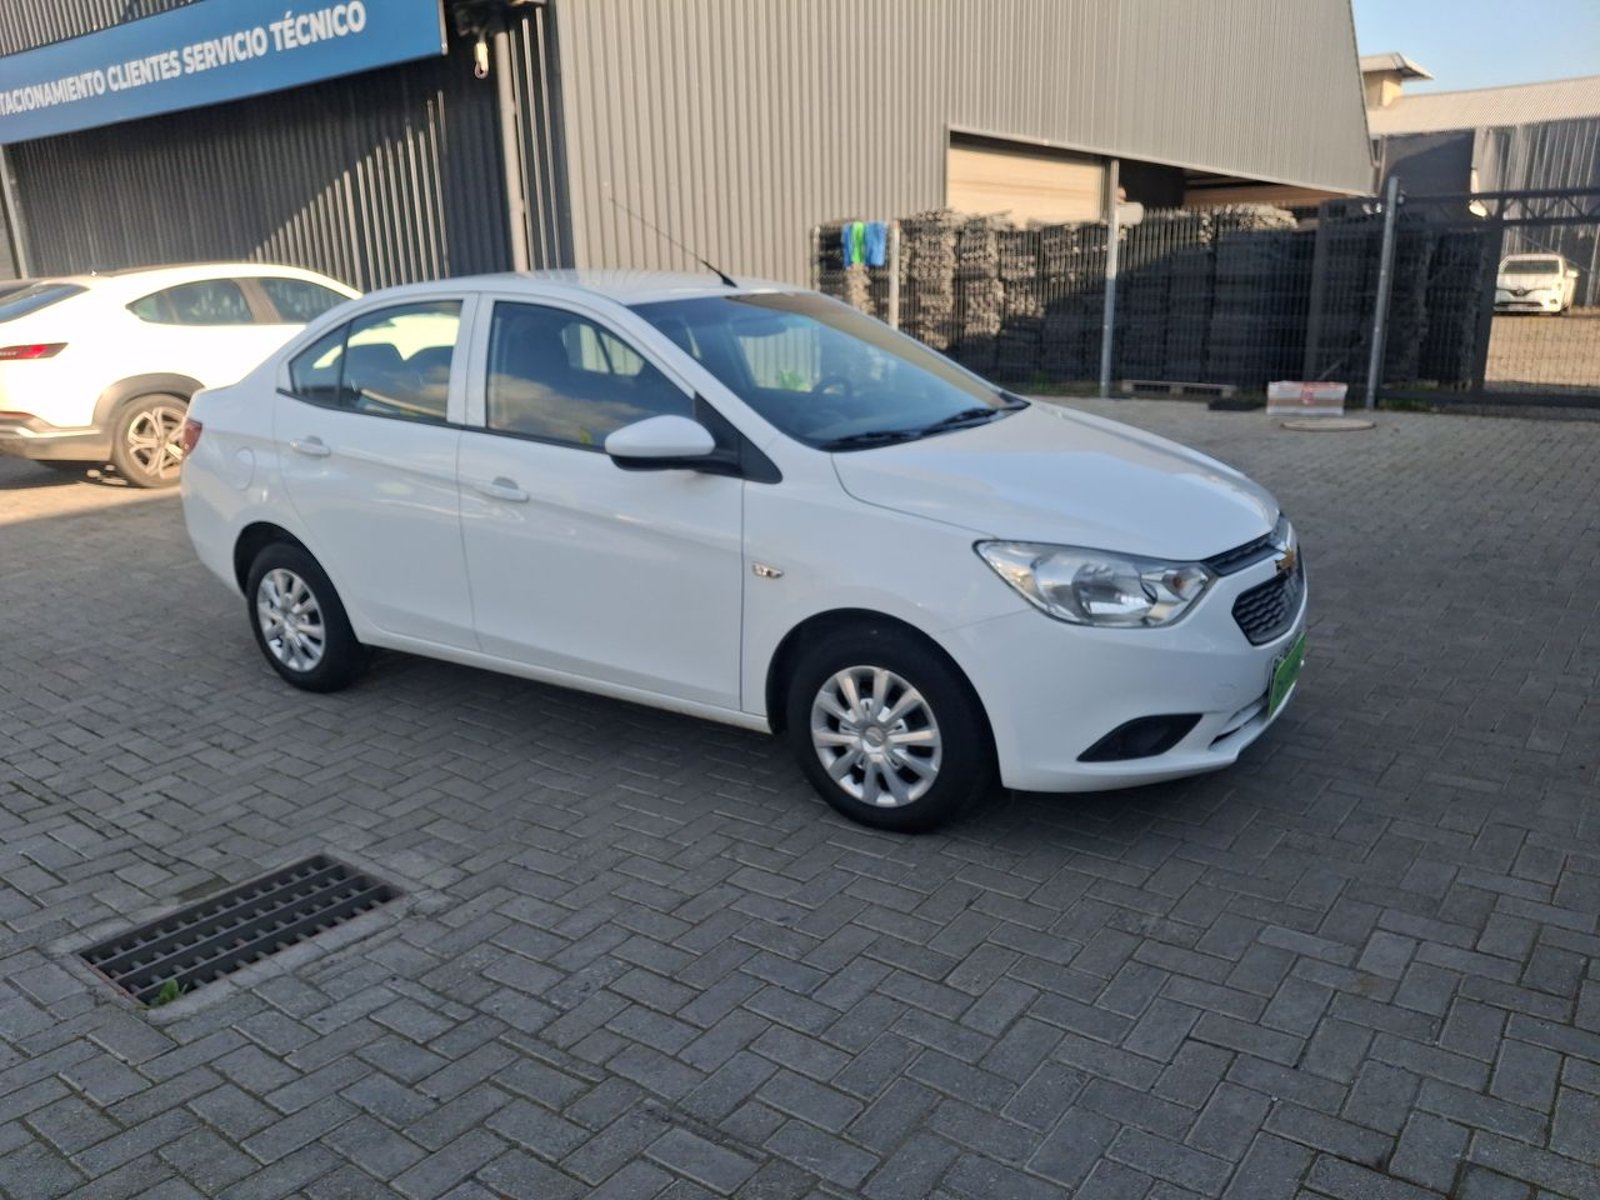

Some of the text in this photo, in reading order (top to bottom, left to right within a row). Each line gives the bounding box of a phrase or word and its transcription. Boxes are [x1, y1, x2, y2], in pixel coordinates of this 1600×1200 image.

[107, 50, 182, 92] CLIENTES
[182, 26, 268, 74] SERVICIO
[269, 0, 366, 52] TÉCNICO
